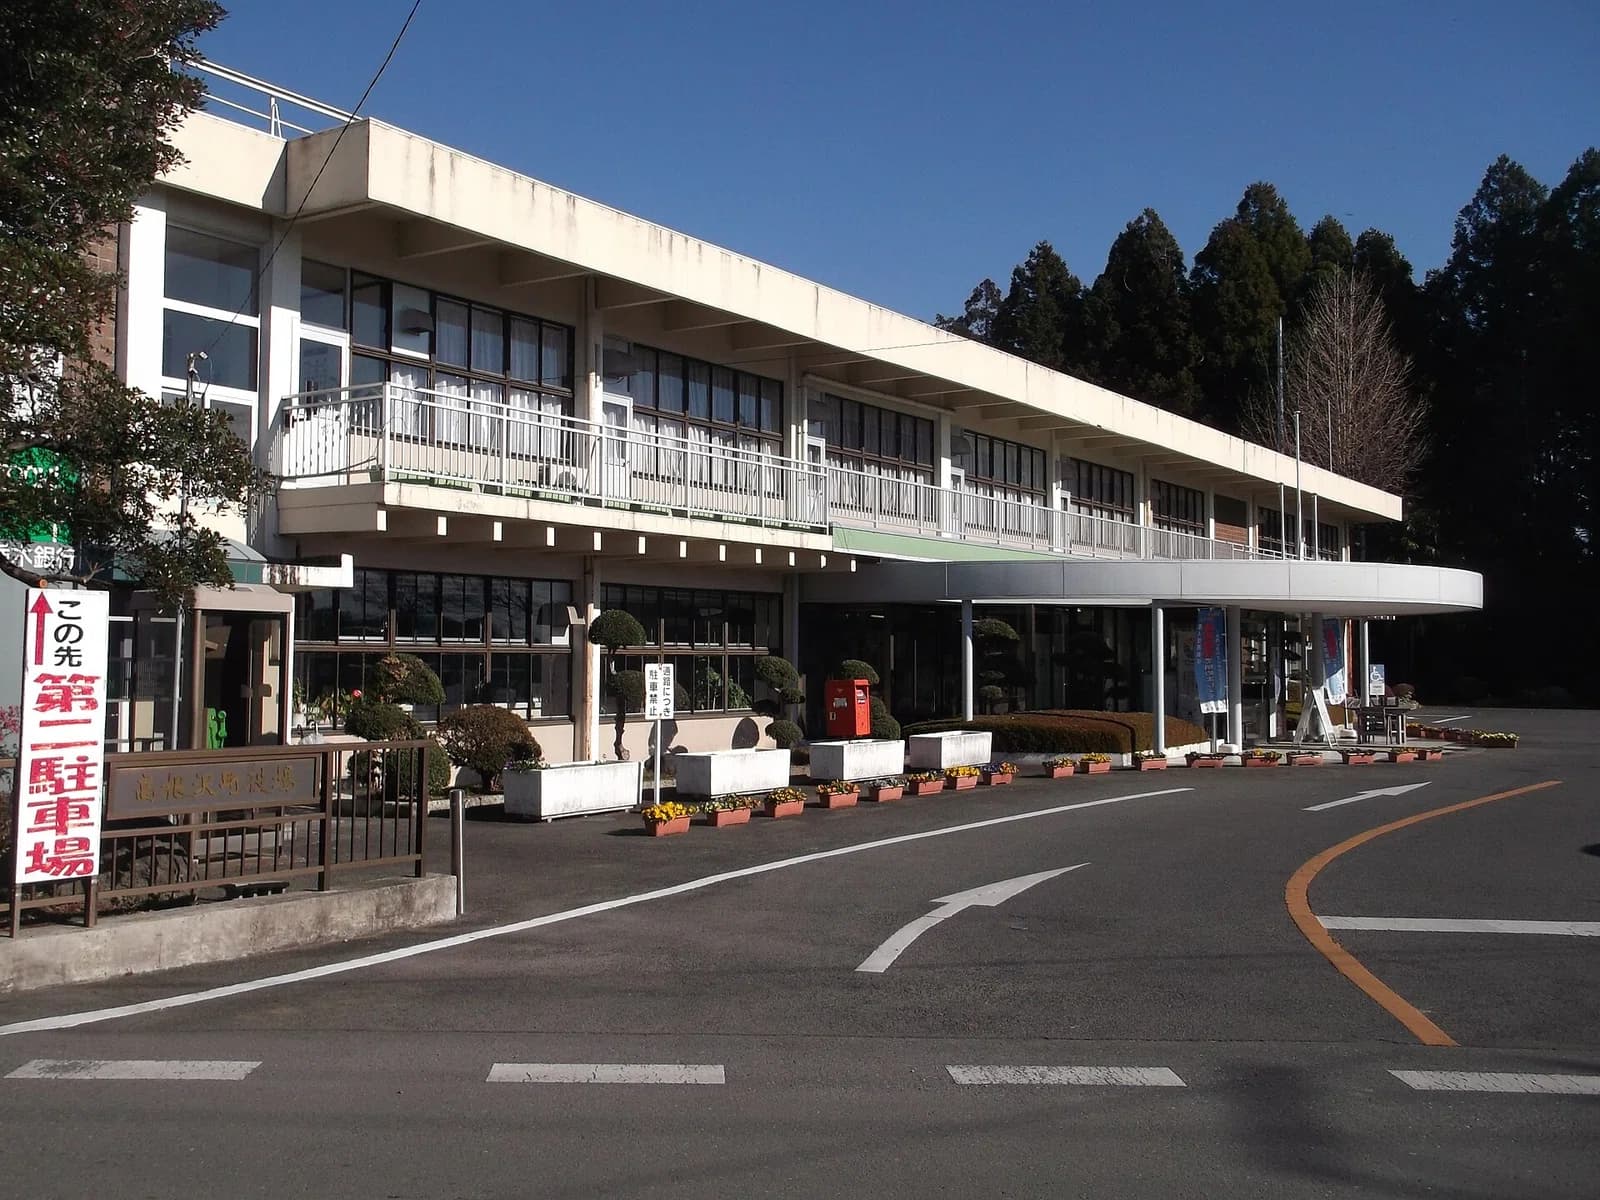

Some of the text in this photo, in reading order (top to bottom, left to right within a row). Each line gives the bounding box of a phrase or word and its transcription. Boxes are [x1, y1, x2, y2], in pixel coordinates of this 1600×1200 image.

[53, 600, 84, 667] この先
[649, 669, 658, 716] 駐車禁止
[662, 666, 671, 717] 通路につき
[25, 673, 101, 877] 第二駐車場
